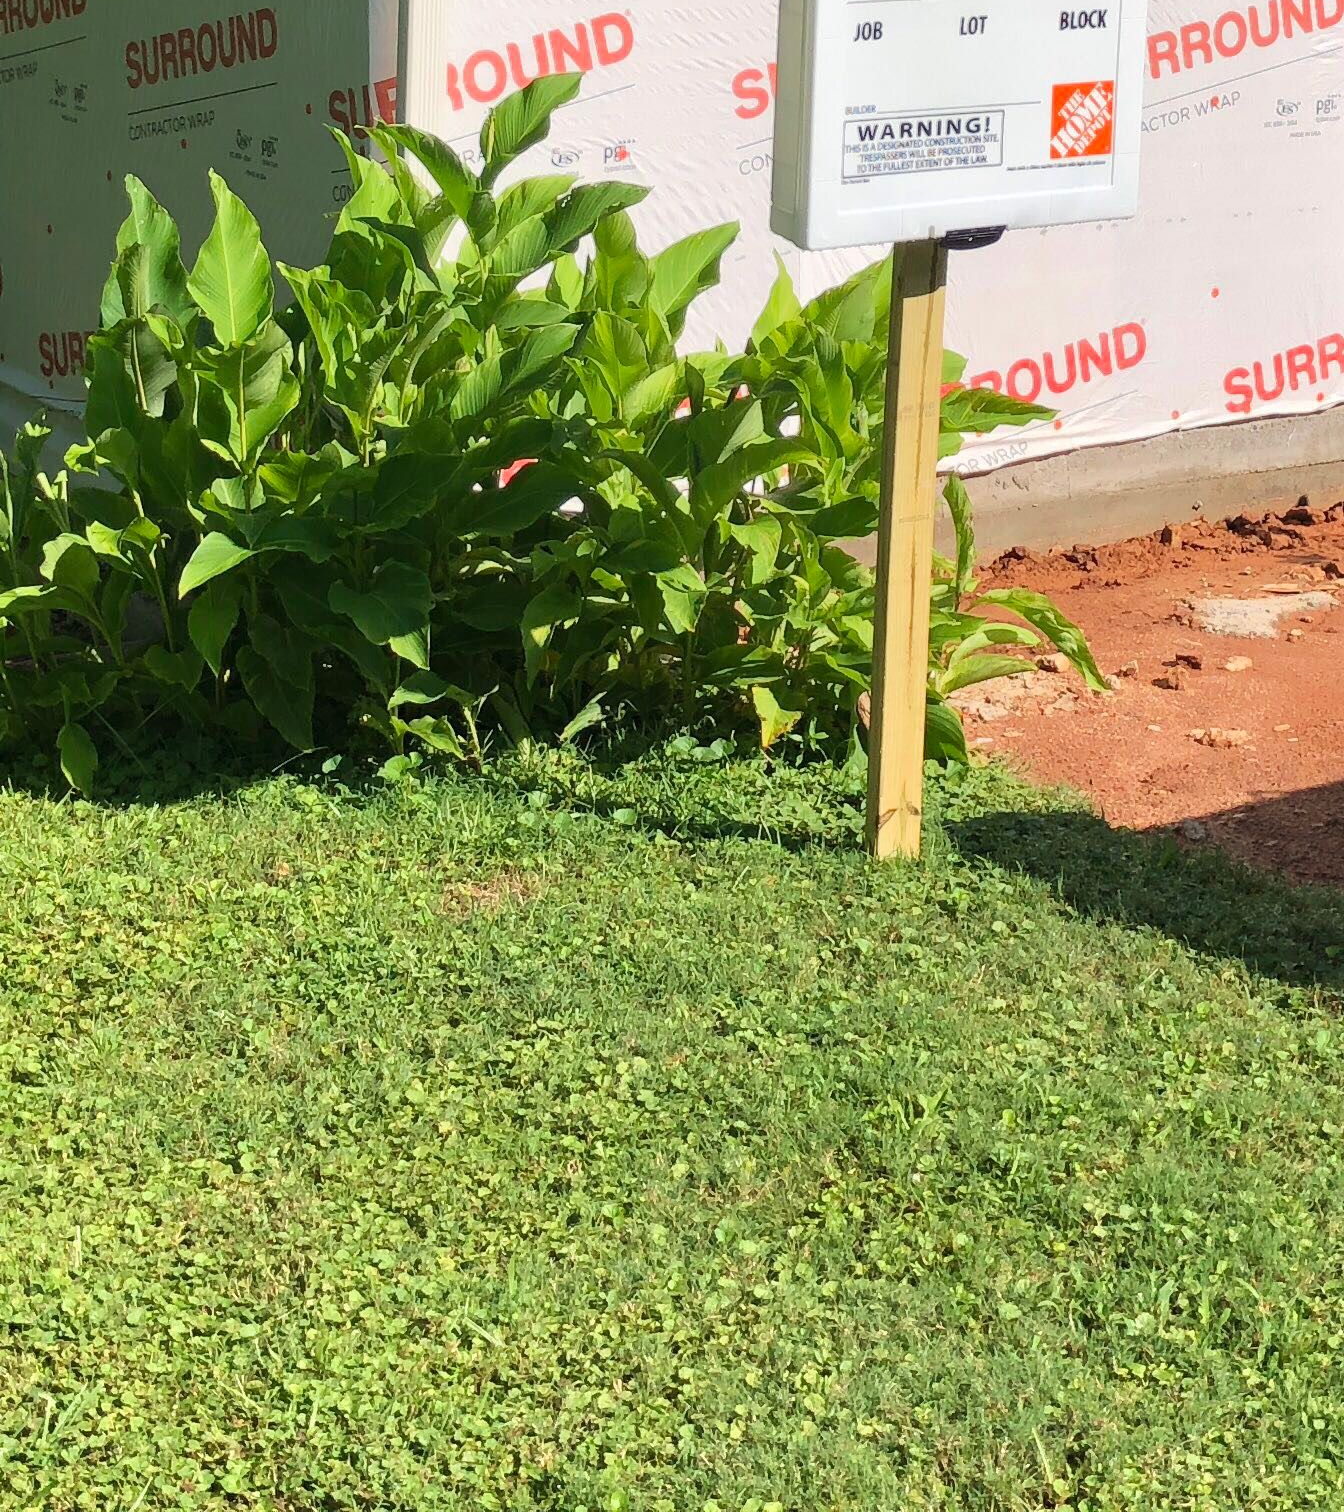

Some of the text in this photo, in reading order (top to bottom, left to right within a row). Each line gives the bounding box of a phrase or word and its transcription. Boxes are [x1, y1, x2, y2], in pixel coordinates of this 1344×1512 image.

[854, 9, 1108, 42] JOB LOT BLOCK
[125, 7, 279, 89] SURROUND
[844, 104, 877, 116] BUILDER
[1058, 88, 1086, 120] THE
[1193, 90, 1241, 117] WRAP
[128, 110, 216, 141] CONTRACTOR WRAP
[856, 114, 992, 143] WARNING!
[1051, 81, 1113, 158] HOME
[1073, 106, 1112, 154] DEPOT
[845, 143, 861, 154] THIS
[877, 139, 923, 152] DESIGNATED
[924, 134, 982, 149] CONSTRUCTION
[859, 144, 986, 164] TRESPASSERS WILL BE PROSECUTED
[867, 162, 882, 173] THE
[883, 159, 914, 172] FULLEST
[914, 157, 943, 169] EXTENT
[944, 157, 954, 167] OF
[955, 155, 970, 166] THE
[39, 330, 95, 378] SUR
